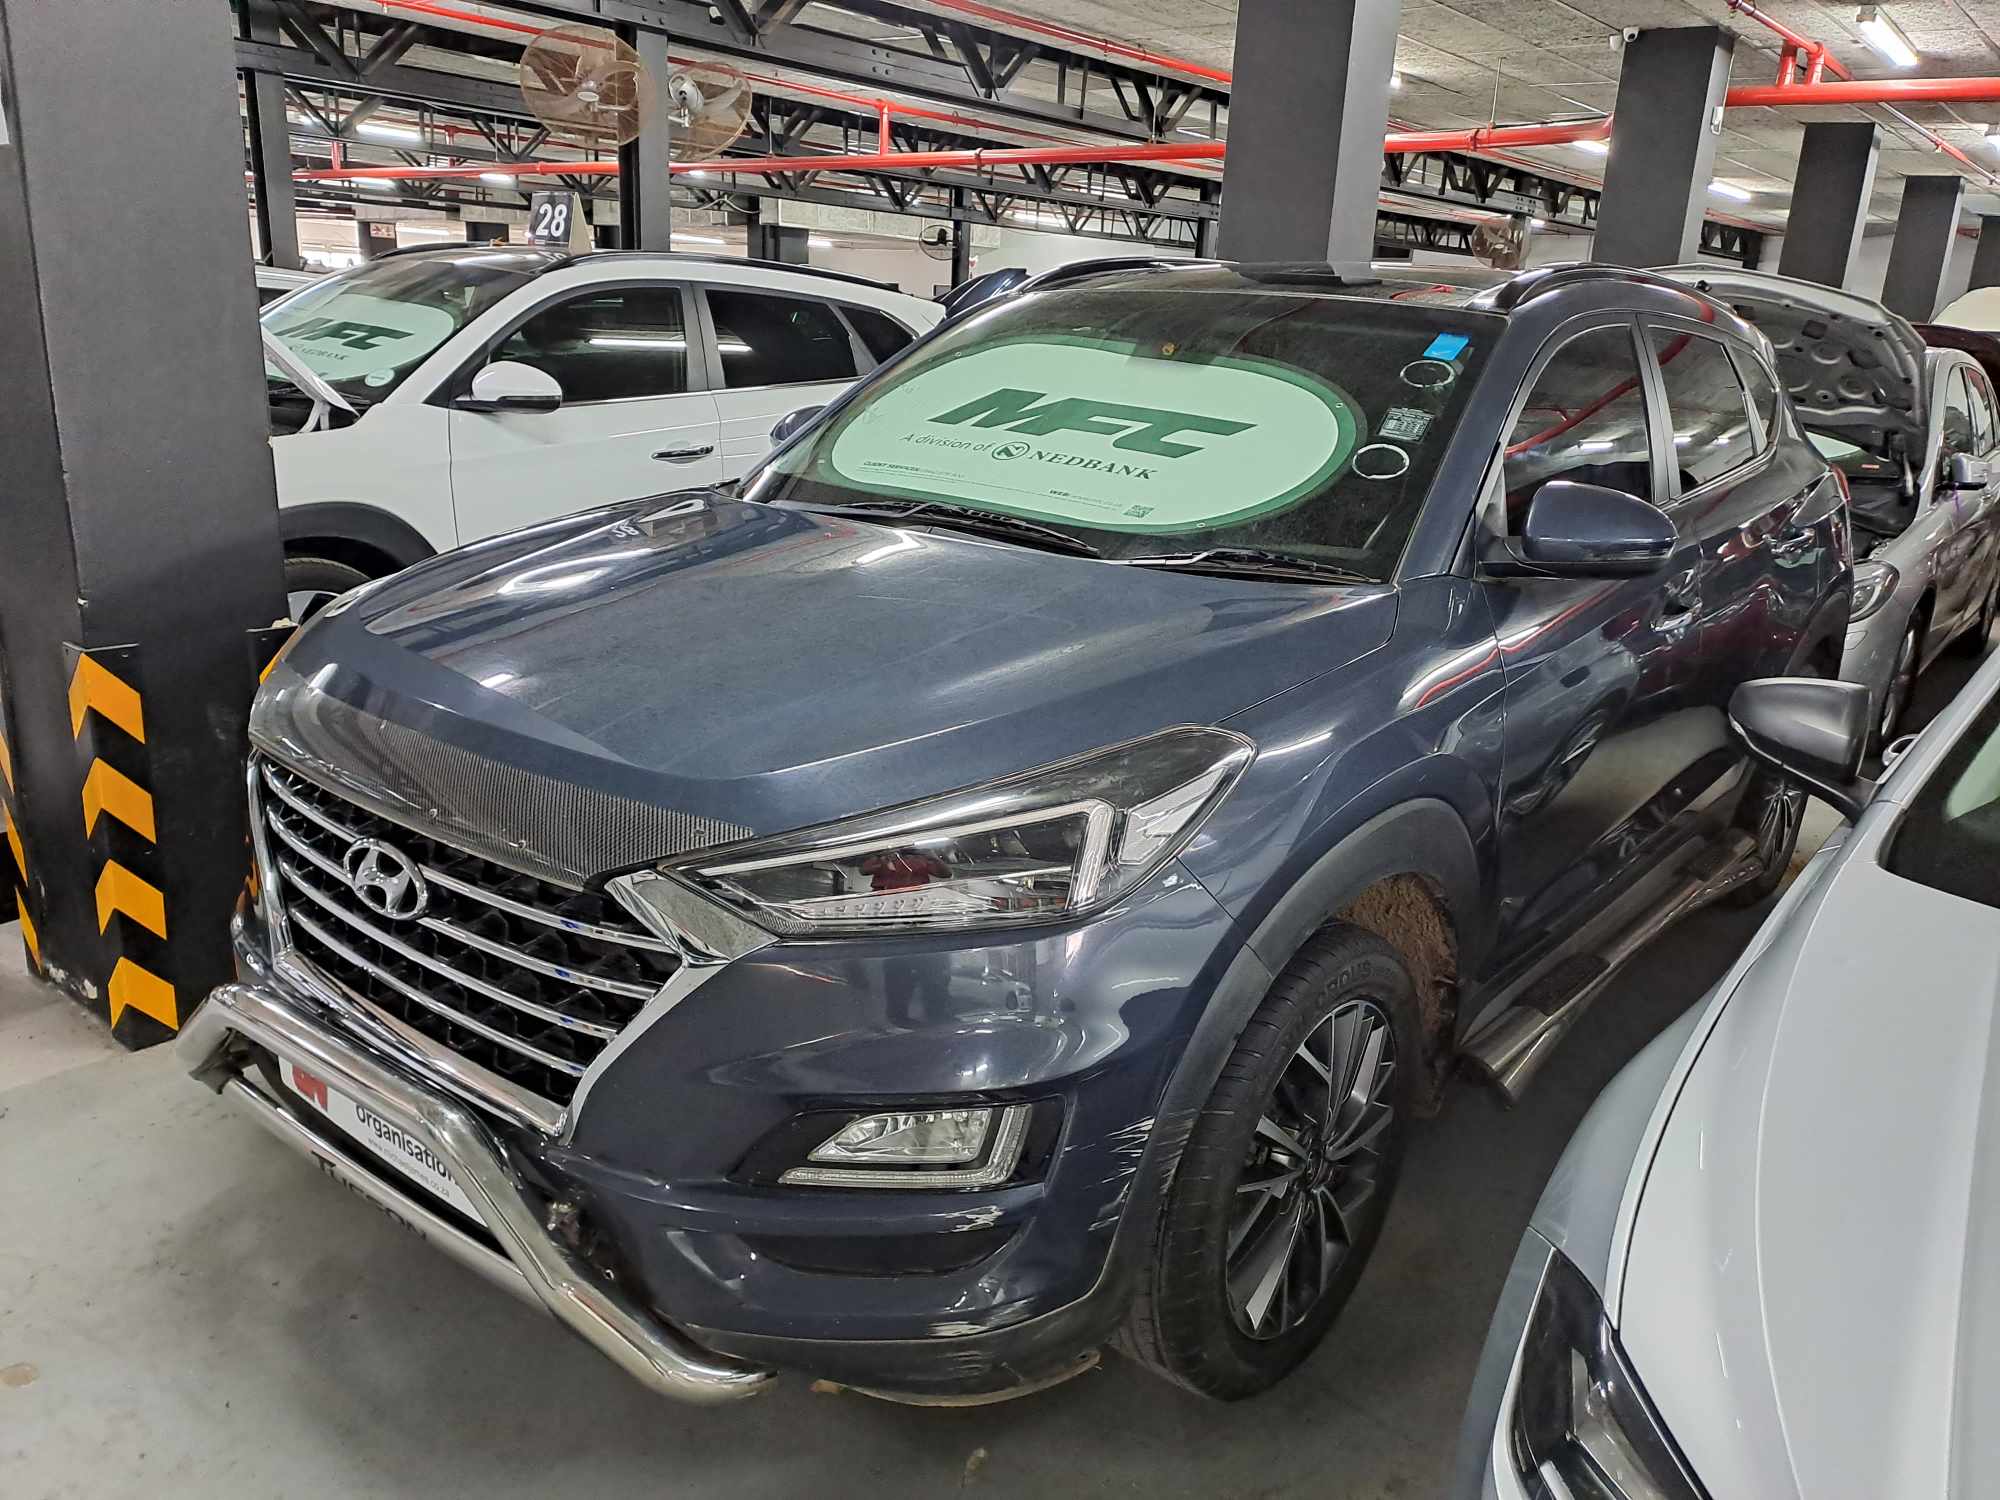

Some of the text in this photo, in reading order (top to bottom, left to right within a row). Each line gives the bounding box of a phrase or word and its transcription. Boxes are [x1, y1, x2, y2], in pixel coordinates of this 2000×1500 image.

[535, 203, 568, 238] 28
[273, 317, 415, 350] MFC
[926, 387, 1259, 459] MFC
[898, 433, 1159, 480] A division of NEDBANK
